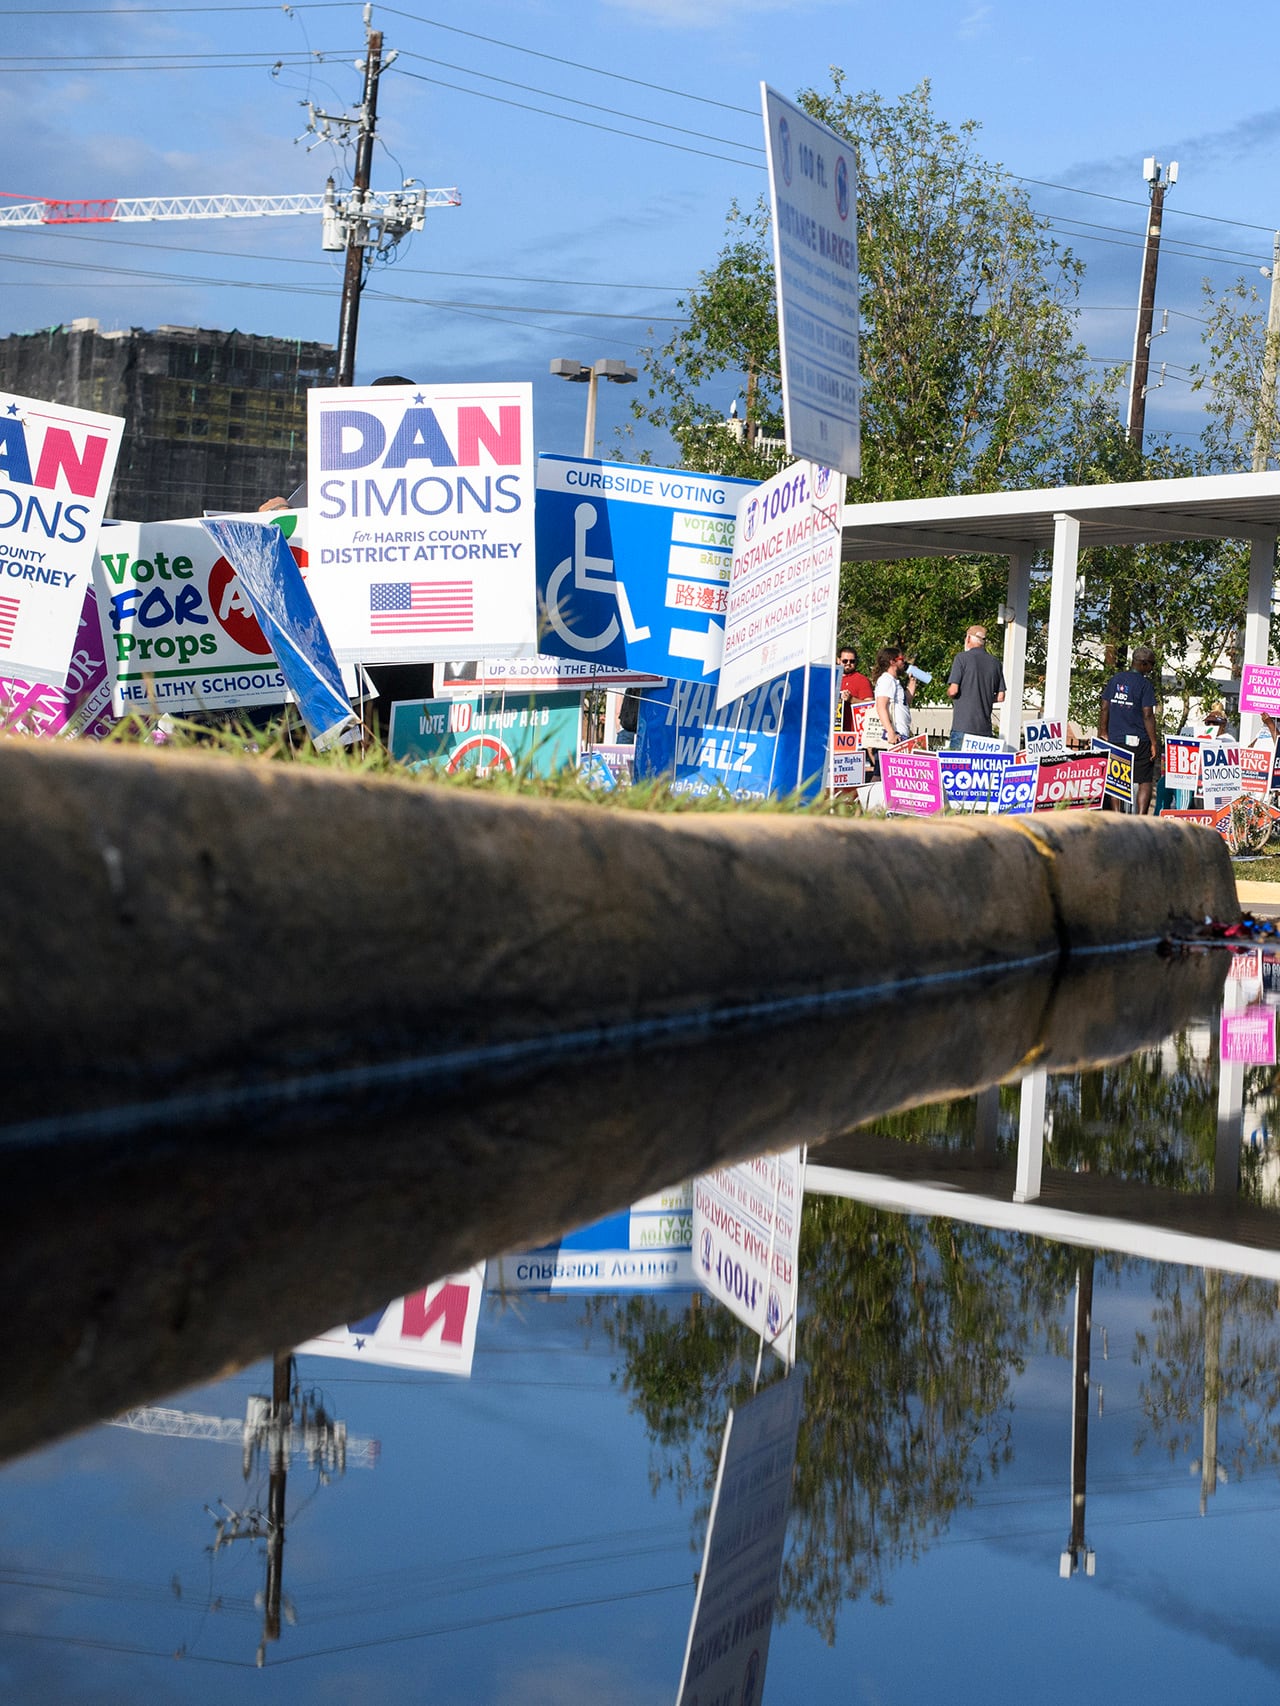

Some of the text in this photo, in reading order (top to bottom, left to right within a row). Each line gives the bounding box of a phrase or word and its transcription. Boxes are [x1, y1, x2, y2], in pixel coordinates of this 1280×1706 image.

[320, 405, 522, 472] DAN
[319, 474, 522, 519] SIMONS
[566, 470, 726, 505] CURBSIDE VOTING
[374, 531, 425, 543] HARRIS
[428, 529, 488, 542] COUNTY
[701, 532, 716, 544] LA
[733, 503, 838, 580] DISTANCE MARKER
[320, 542, 523, 564] DISTRICT ATTORNEY
[101, 552, 194, 584] Vote
[730, 546, 834, 613] MARCADOR DE DISTANCIA
[109, 584, 209, 631] FOR
[113, 633, 218, 665] Props
[489, 664, 632, 676] UP & DOWN THE BALLO
[120, 680, 196, 700] HEALTHY
[202, 672, 285, 693] SCHOOLS
[419, 714, 445, 735] VOTE
[449, 703, 472, 733] NO
[837, 735, 856, 747] NO
[1027, 722, 1062, 742] DAN
[675, 735, 758, 773] WALZ
[965, 739, 1001, 752] TRUMP
[1028, 739, 1063, 754] SIMONS
[1169, 745, 1177, 773] BRUCE
[1203, 748, 1239, 767] DAN
[1240, 758, 1268, 772] ING
[887, 766, 934, 781] JERALYNN
[942, 771, 1001, 790] GOME
[1053, 765, 1100, 780] Jolanda
[1204, 767, 1240, 780] SIMONS
[895, 778, 930, 792] MANOR
[1037, 778, 1104, 802] JONES
